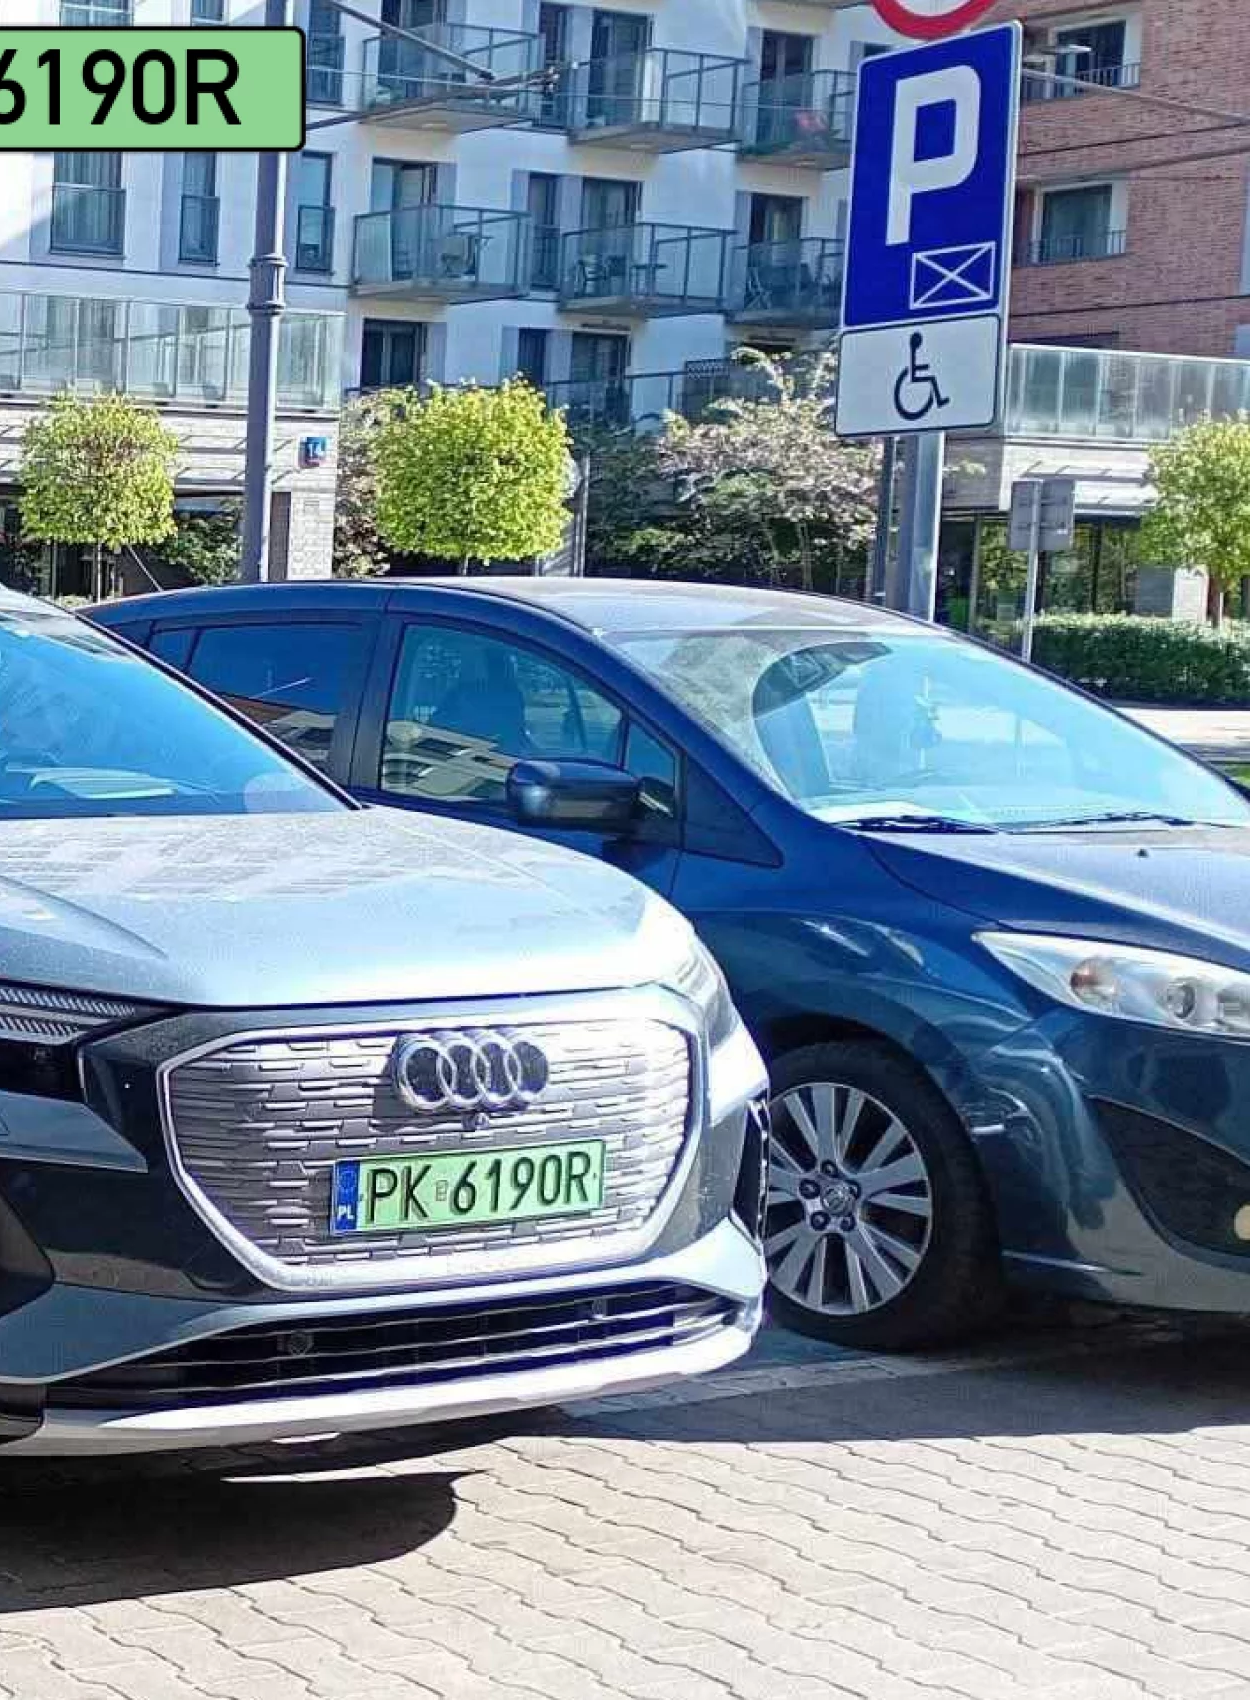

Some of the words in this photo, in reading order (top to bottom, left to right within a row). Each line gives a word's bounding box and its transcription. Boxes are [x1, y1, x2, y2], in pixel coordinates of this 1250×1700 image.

[885, 64, 982, 246] P
[336, 1205, 354, 1220] PL
[366, 1163, 433, 1223] PK
[452, 1150, 591, 1216] 6190R
